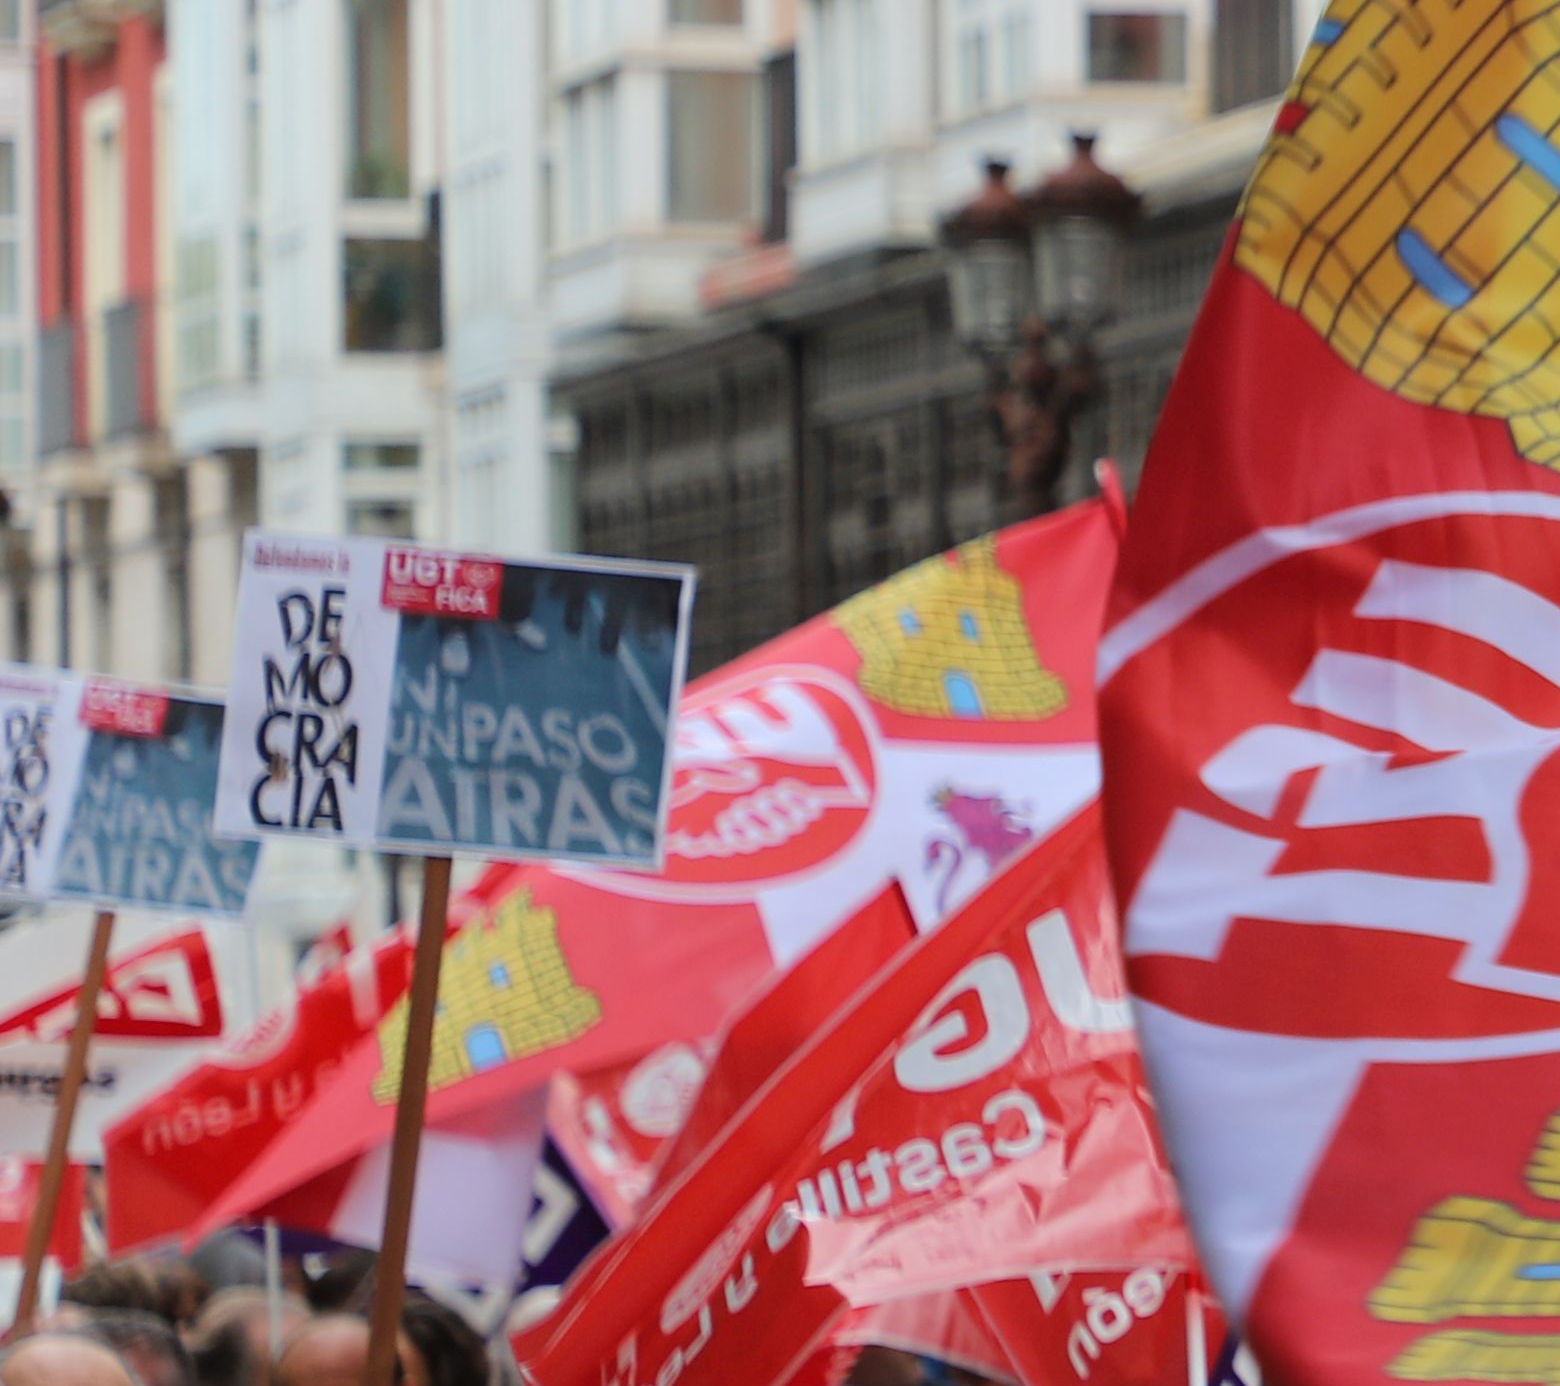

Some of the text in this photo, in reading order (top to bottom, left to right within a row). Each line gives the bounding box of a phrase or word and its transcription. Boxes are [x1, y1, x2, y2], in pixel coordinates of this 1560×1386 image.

[389, 551, 463, 586] UGT
[277, 588, 346, 648] DE
[262, 651, 354, 712] MO
[255, 710, 359, 786] CRA
[462, 702, 638, 774] PASO
[248, 773, 344, 831] CIA
